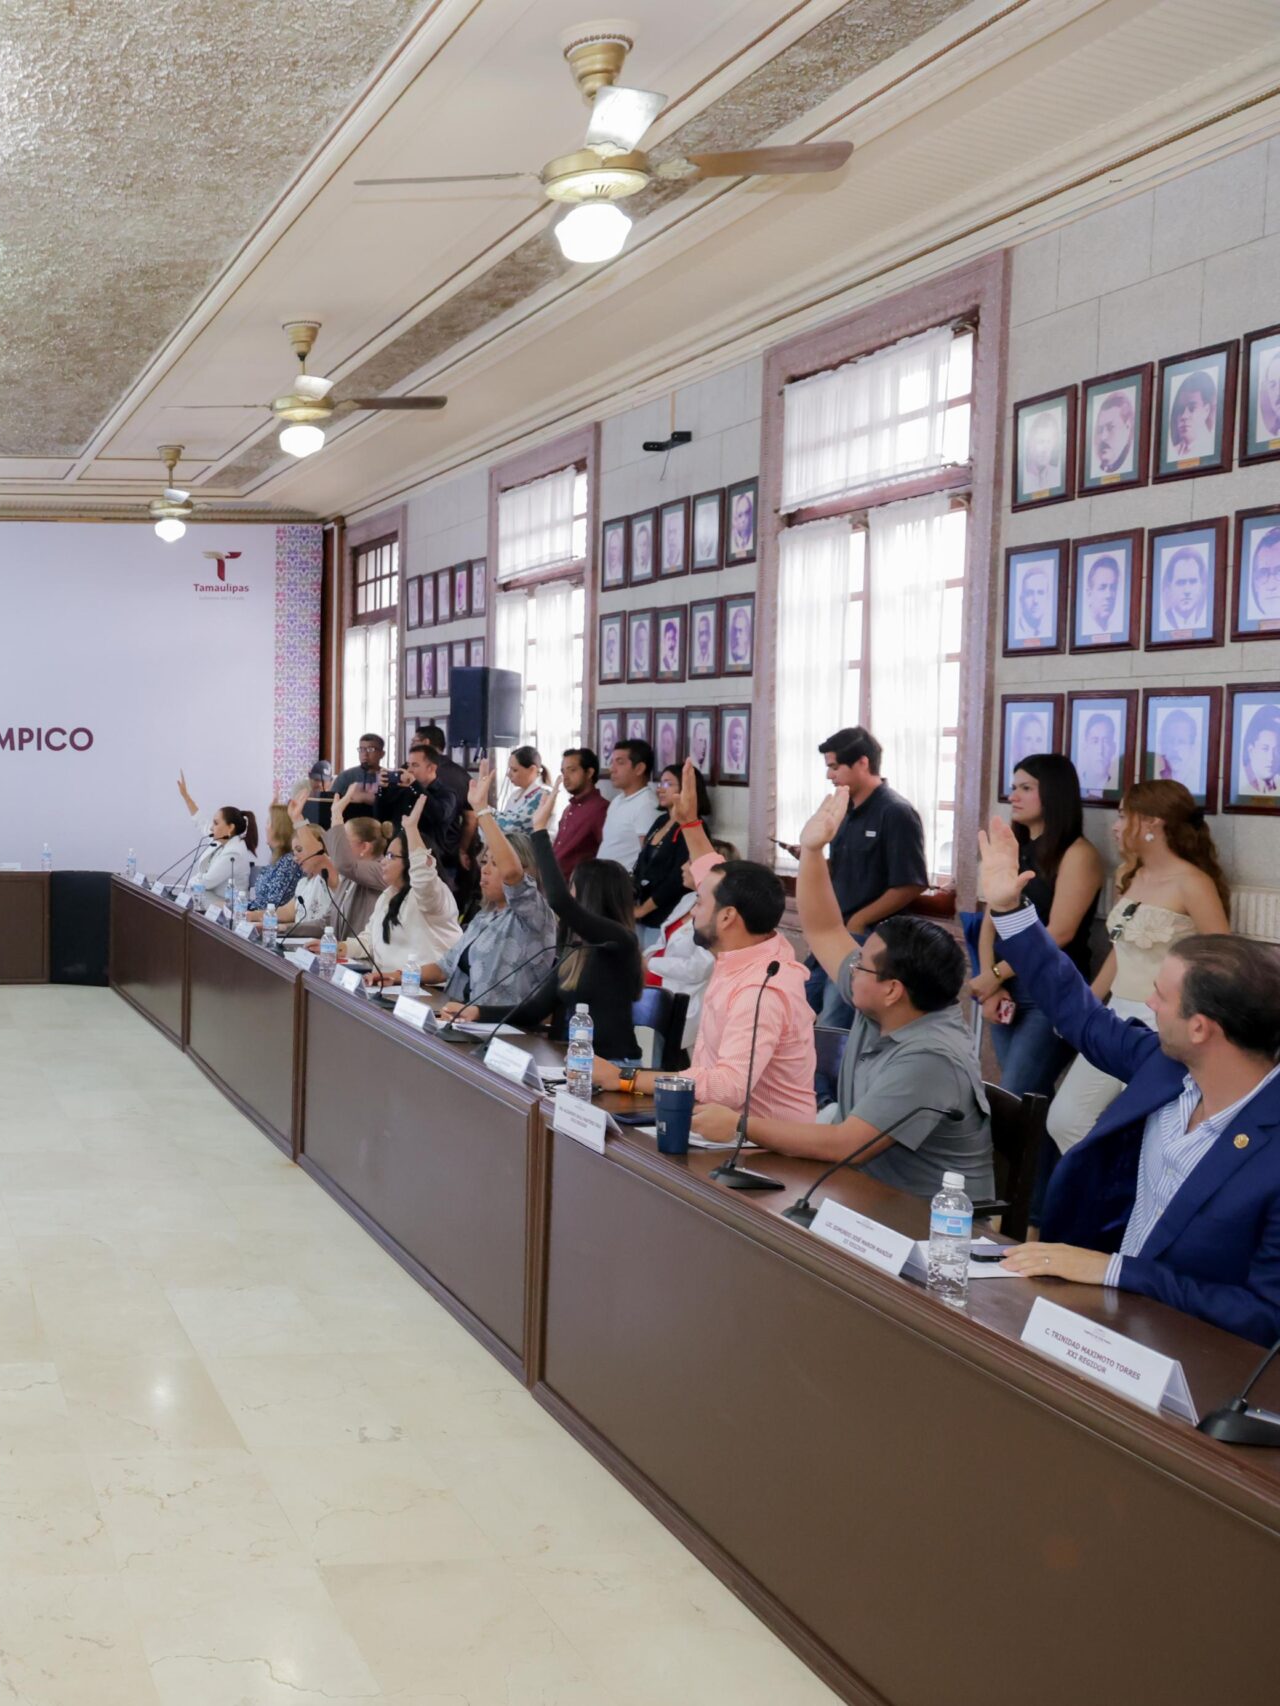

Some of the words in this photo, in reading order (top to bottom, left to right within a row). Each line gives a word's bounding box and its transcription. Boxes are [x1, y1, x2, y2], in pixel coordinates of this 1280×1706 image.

[193, 583, 250, 594] Tamaulipas
[1051, 1330, 1081, 1351] TRINIDAD
[1115, 1363, 1141, 1381] TORRES
[1078, 1354, 1106, 1374] REGIDOR
